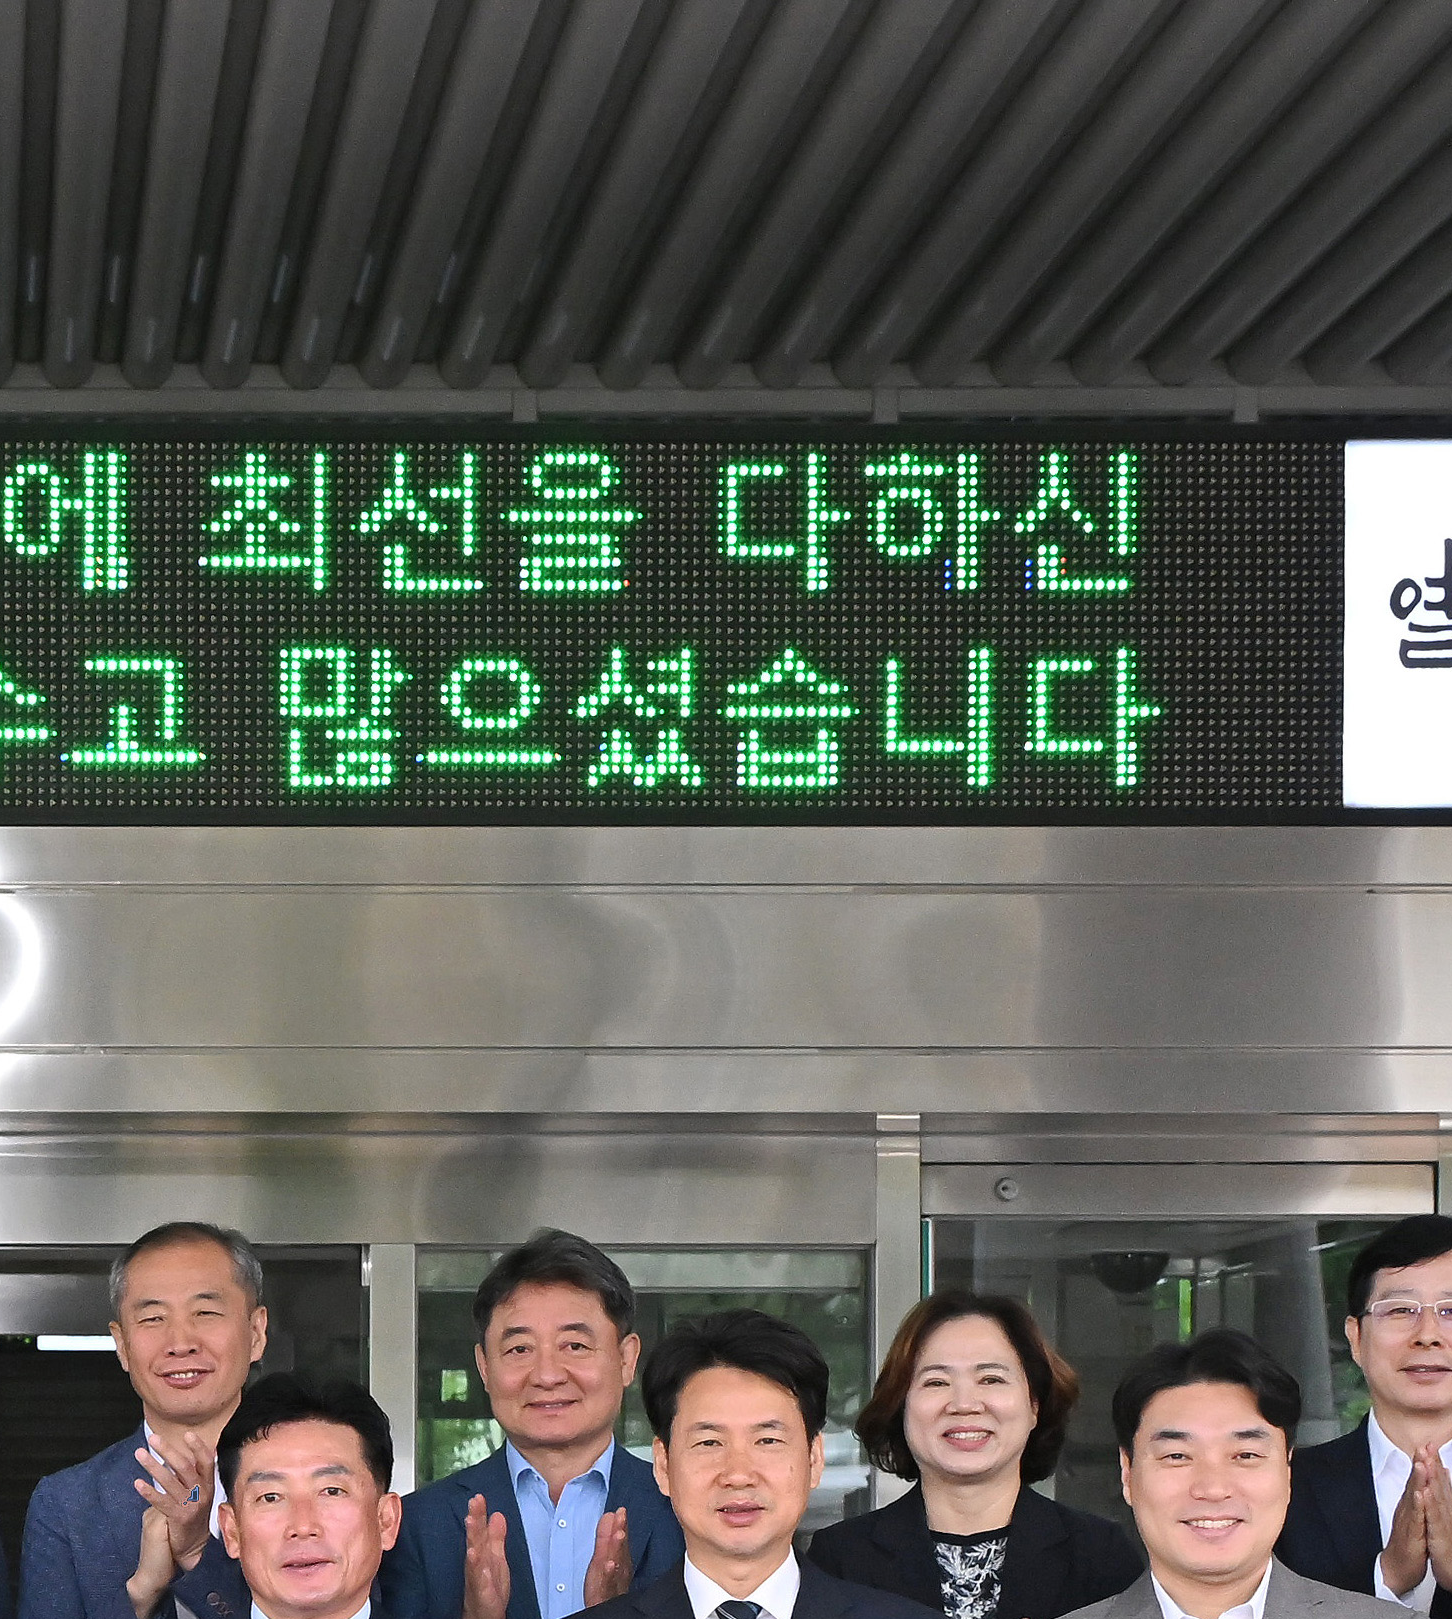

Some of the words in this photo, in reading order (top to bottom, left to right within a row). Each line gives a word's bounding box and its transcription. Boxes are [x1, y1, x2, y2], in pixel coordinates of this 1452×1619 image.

[197, 450, 645, 598] 최선을
[716, 450, 1138, 596] 다하신
[278, 642, 1161, 792] 많으셨습니다
